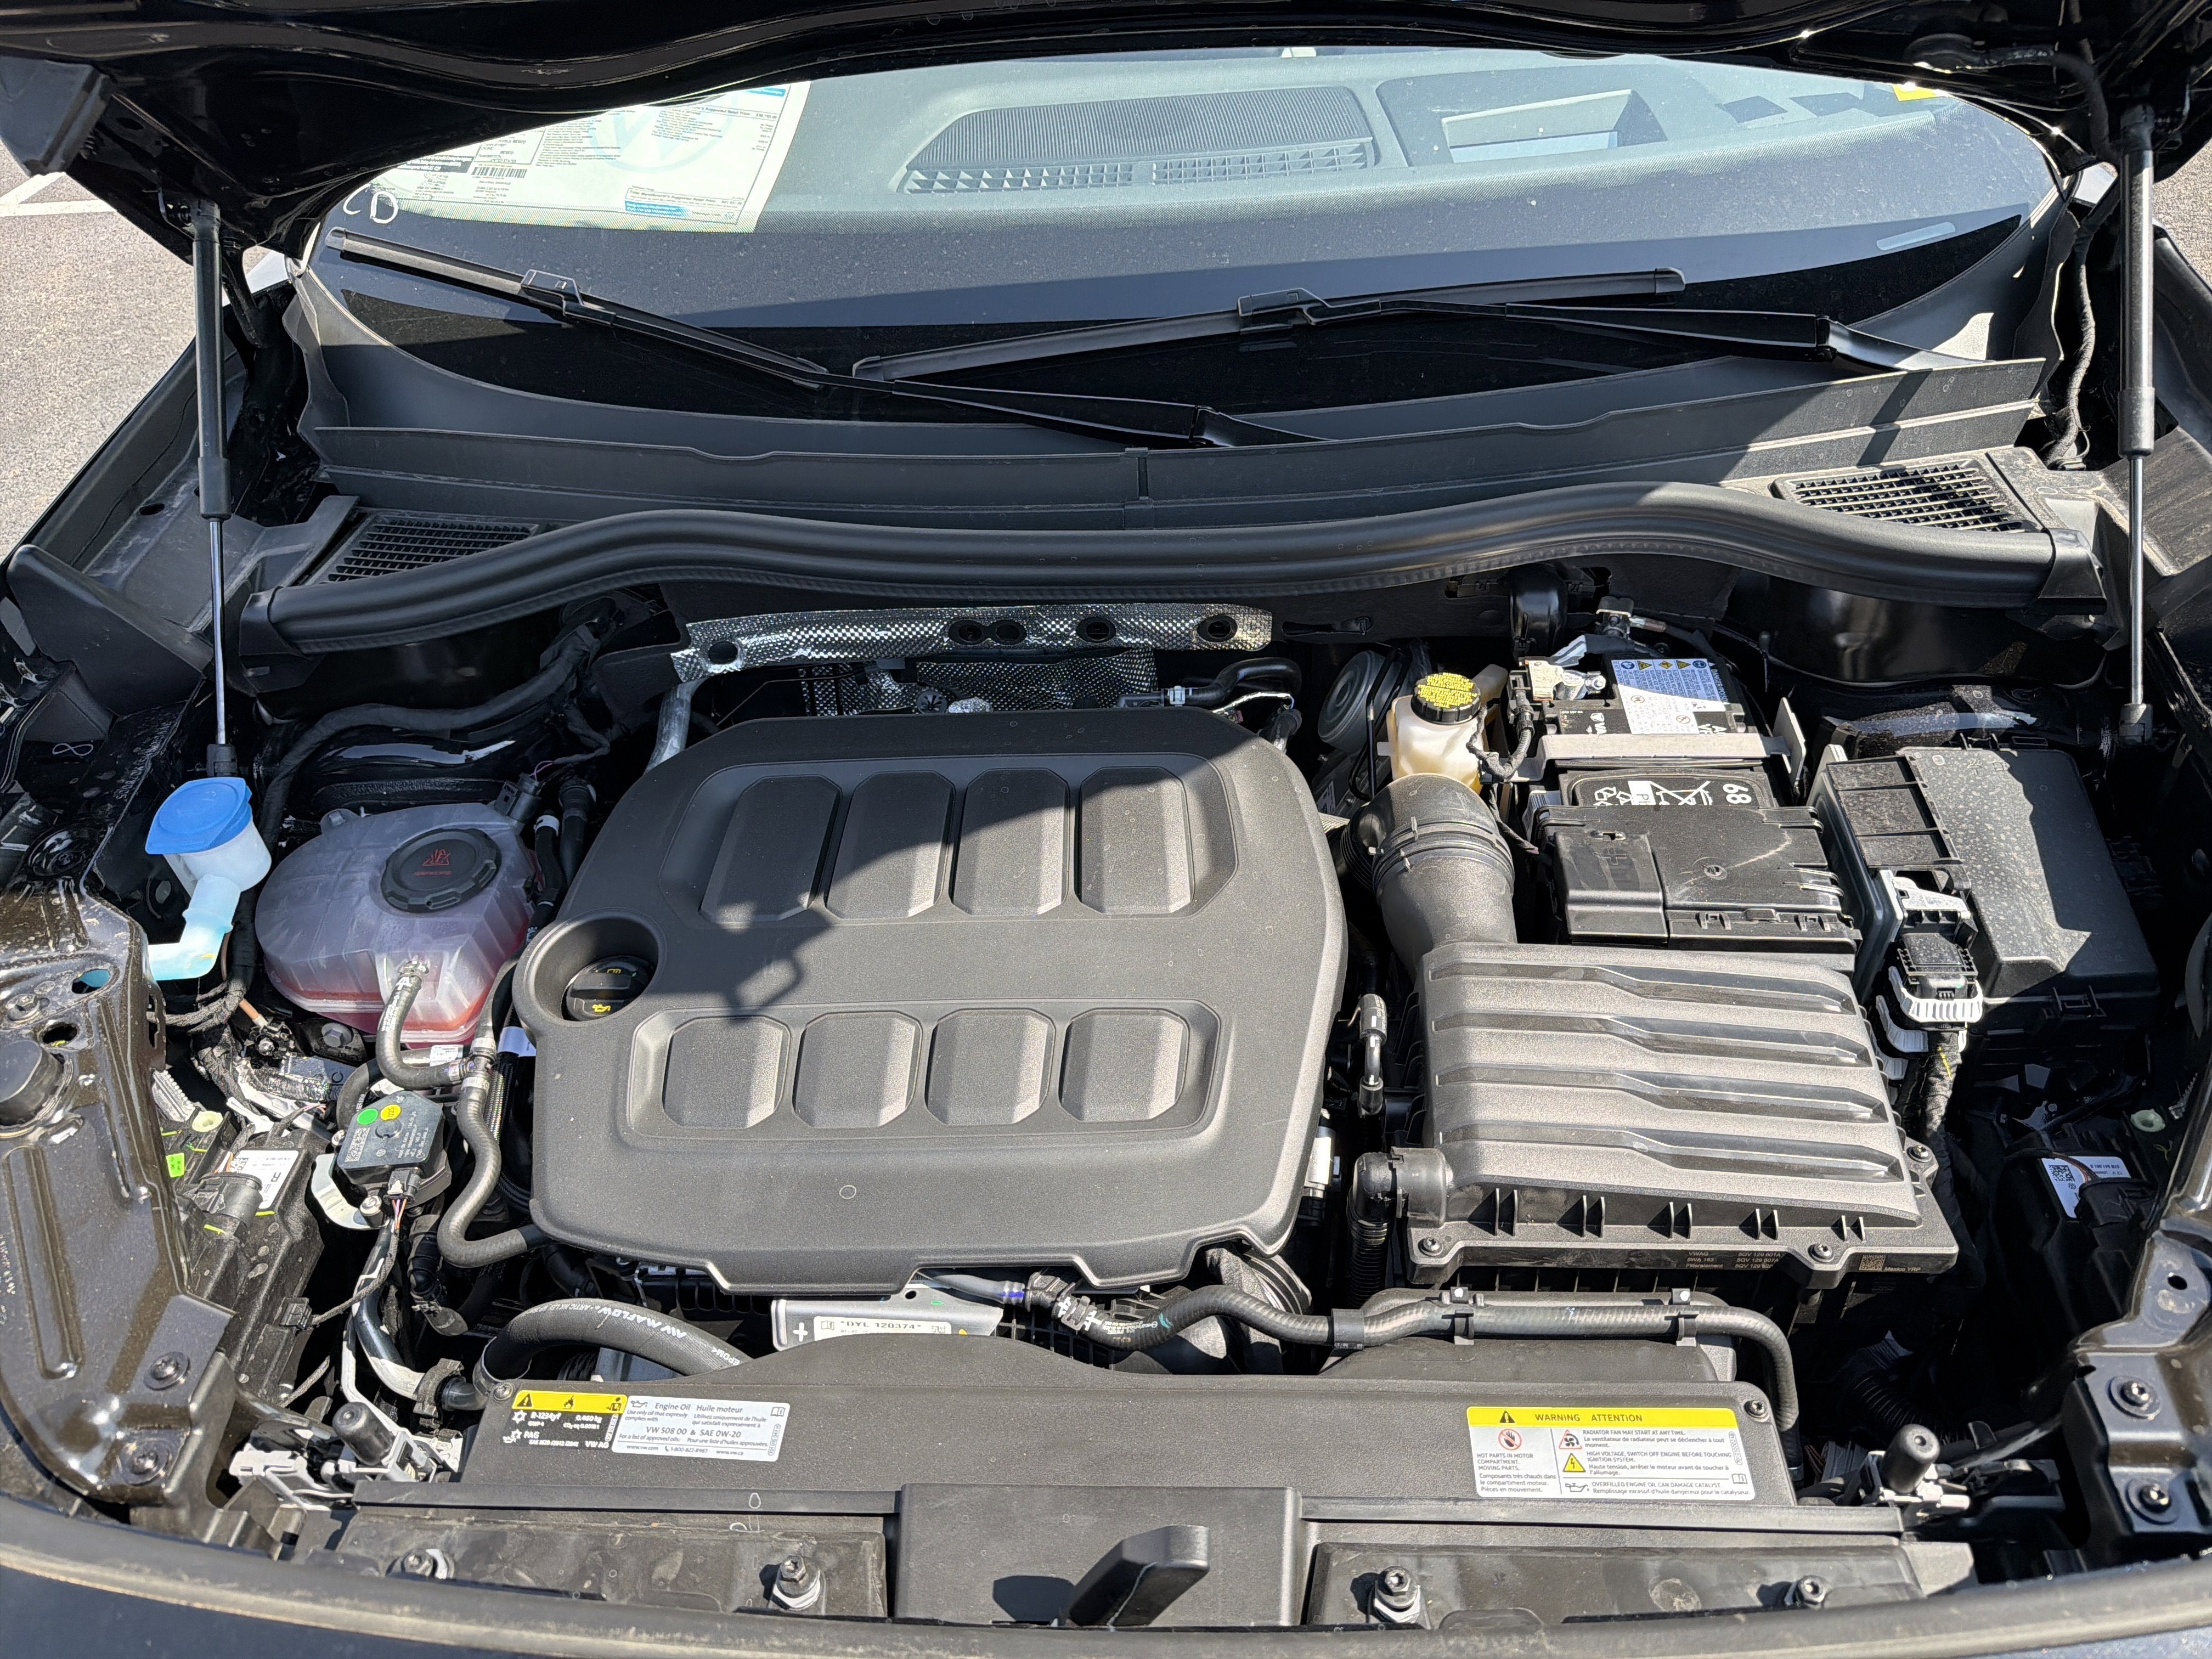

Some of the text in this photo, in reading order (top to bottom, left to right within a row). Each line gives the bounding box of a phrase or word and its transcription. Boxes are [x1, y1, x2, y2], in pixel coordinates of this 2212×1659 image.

[1723, 783, 1752, 805] 68
[654, 1402, 679, 1411] Engine
[531, 1412, 562, 1422] R-1234yf
[1535, 1413, 1643, 1422] WARNING ATTENTION
[523, 1431, 540, 1439] PAG
[715, 1430, 742, 1438] 0W-20
